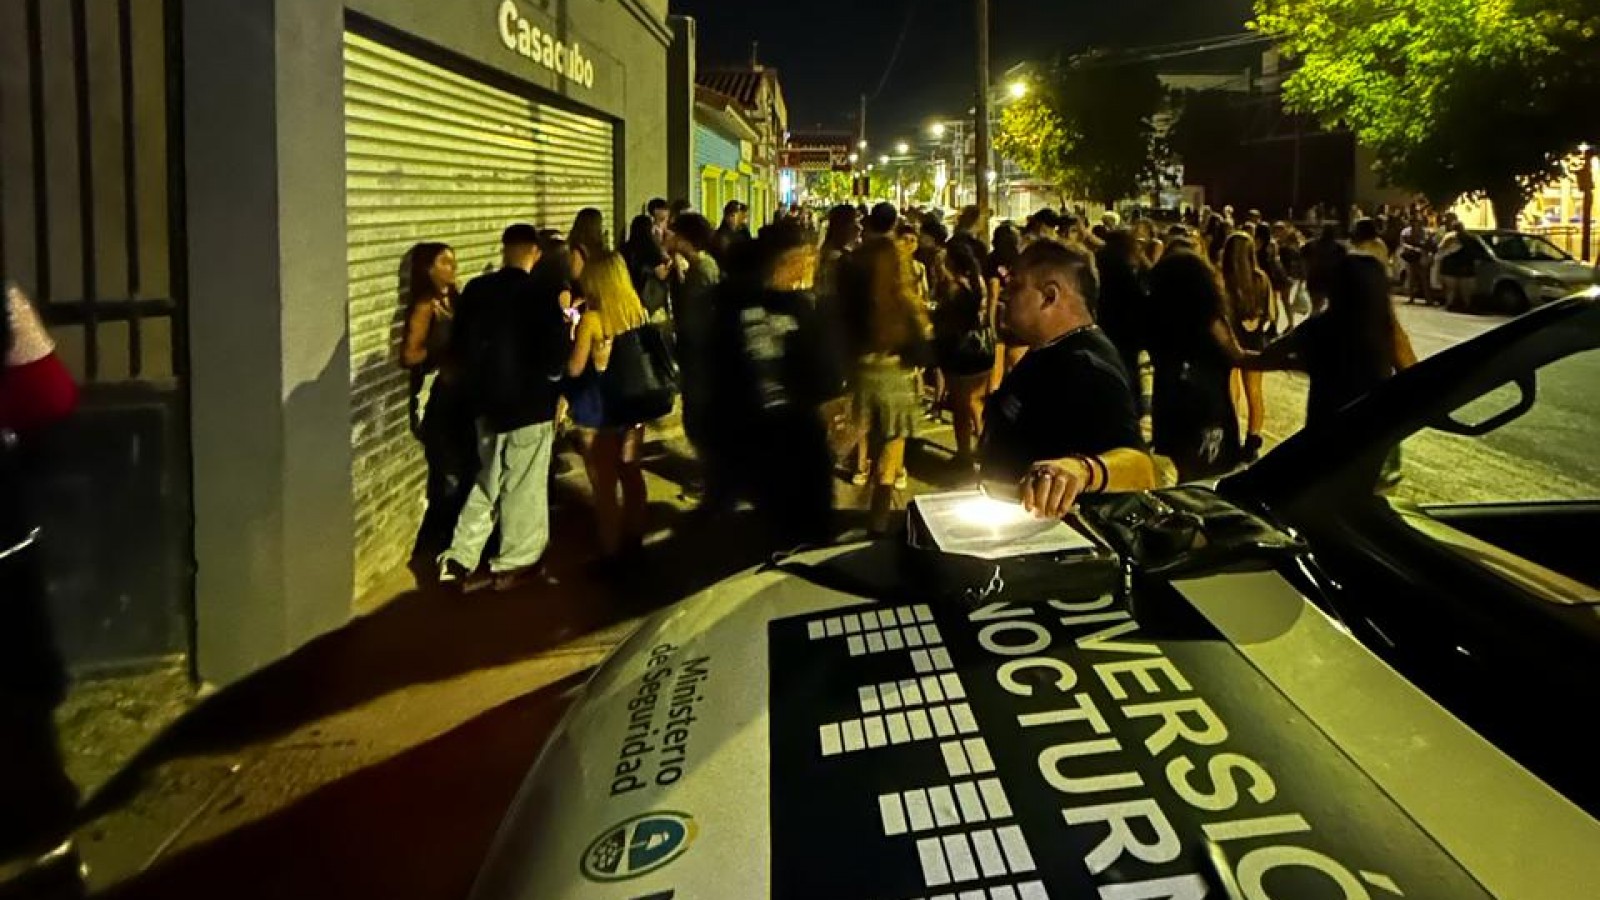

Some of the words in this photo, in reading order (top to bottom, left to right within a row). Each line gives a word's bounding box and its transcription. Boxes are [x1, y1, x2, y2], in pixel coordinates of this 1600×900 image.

[498, 0, 595, 89] Casacubo
[646, 643, 679, 667] de
[609, 667, 673, 797] Seguridad
[655, 655, 711, 786] Ministerio
